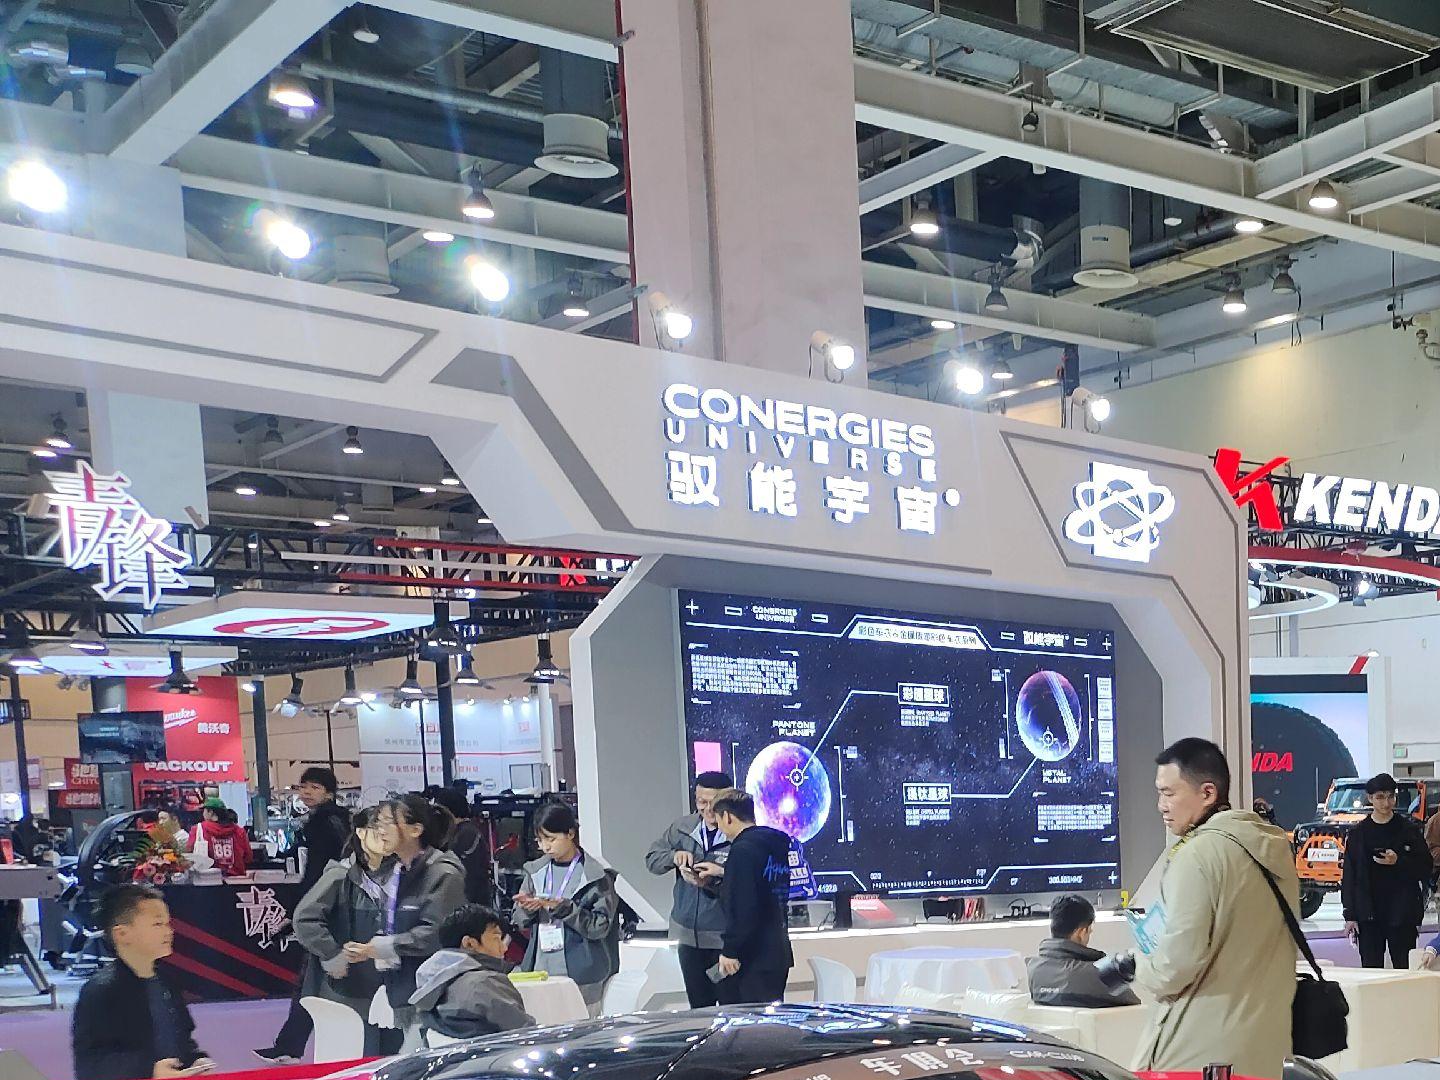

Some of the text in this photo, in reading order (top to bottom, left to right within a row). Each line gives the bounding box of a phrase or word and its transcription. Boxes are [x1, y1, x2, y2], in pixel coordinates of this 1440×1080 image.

[662, 383, 936, 457] CONERGIES
[664, 418, 937, 482] UNIVERSE
[665, 450, 938, 535] 驭能宇宙
[144, 760, 232, 772] PACKOUT
